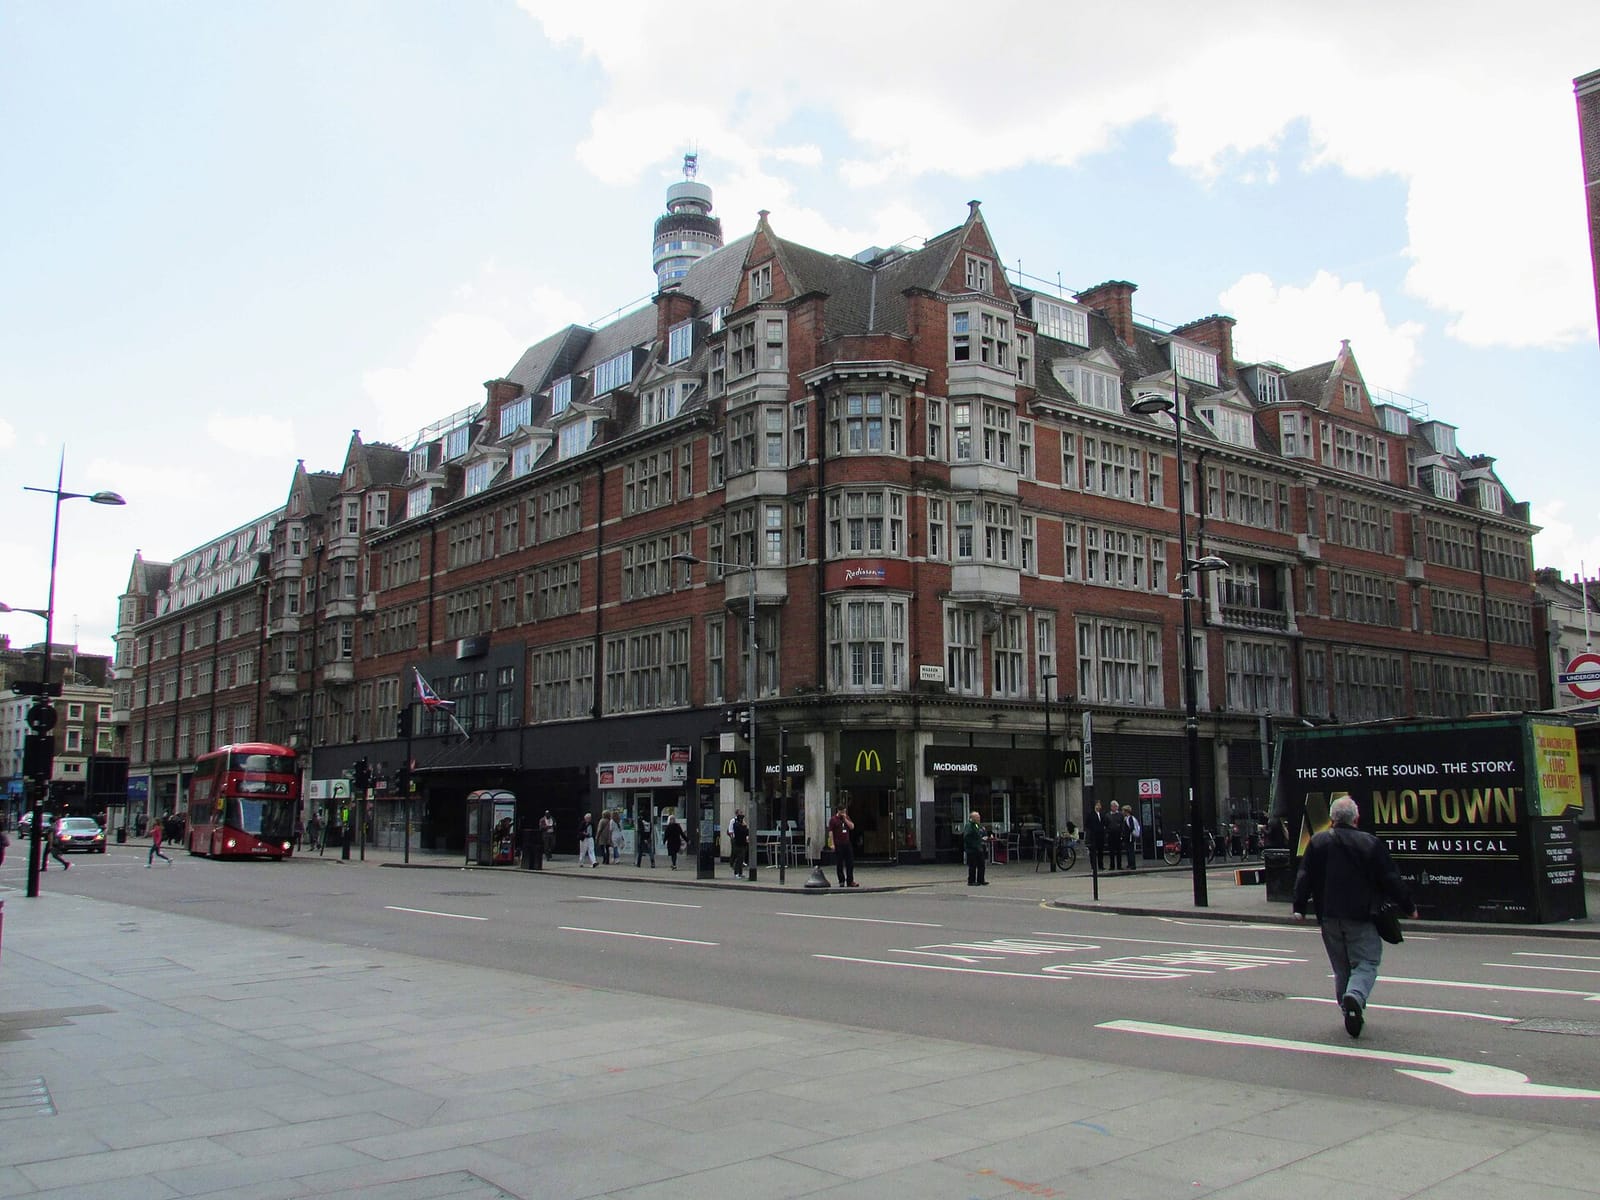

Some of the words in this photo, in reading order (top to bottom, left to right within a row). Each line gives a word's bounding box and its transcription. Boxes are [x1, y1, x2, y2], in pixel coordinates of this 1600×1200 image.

[765, 764, 804, 773] McDnald's
[933, 762, 978, 772] McDonald's
[1296, 768, 1318, 779] THE
[1321, 766, 1362, 778] SONGS.
[1365, 765, 1389, 777] THE
[1392, 764, 1438, 776] SOUND.
[1442, 762, 1468, 774] THE
[1472, 761, 1516, 773] STORY.
[1373, 787, 1517, 824] MOTOWN
[1386, 840, 1417, 850] THE
[1428, 840, 1507, 851] MUSICAL
